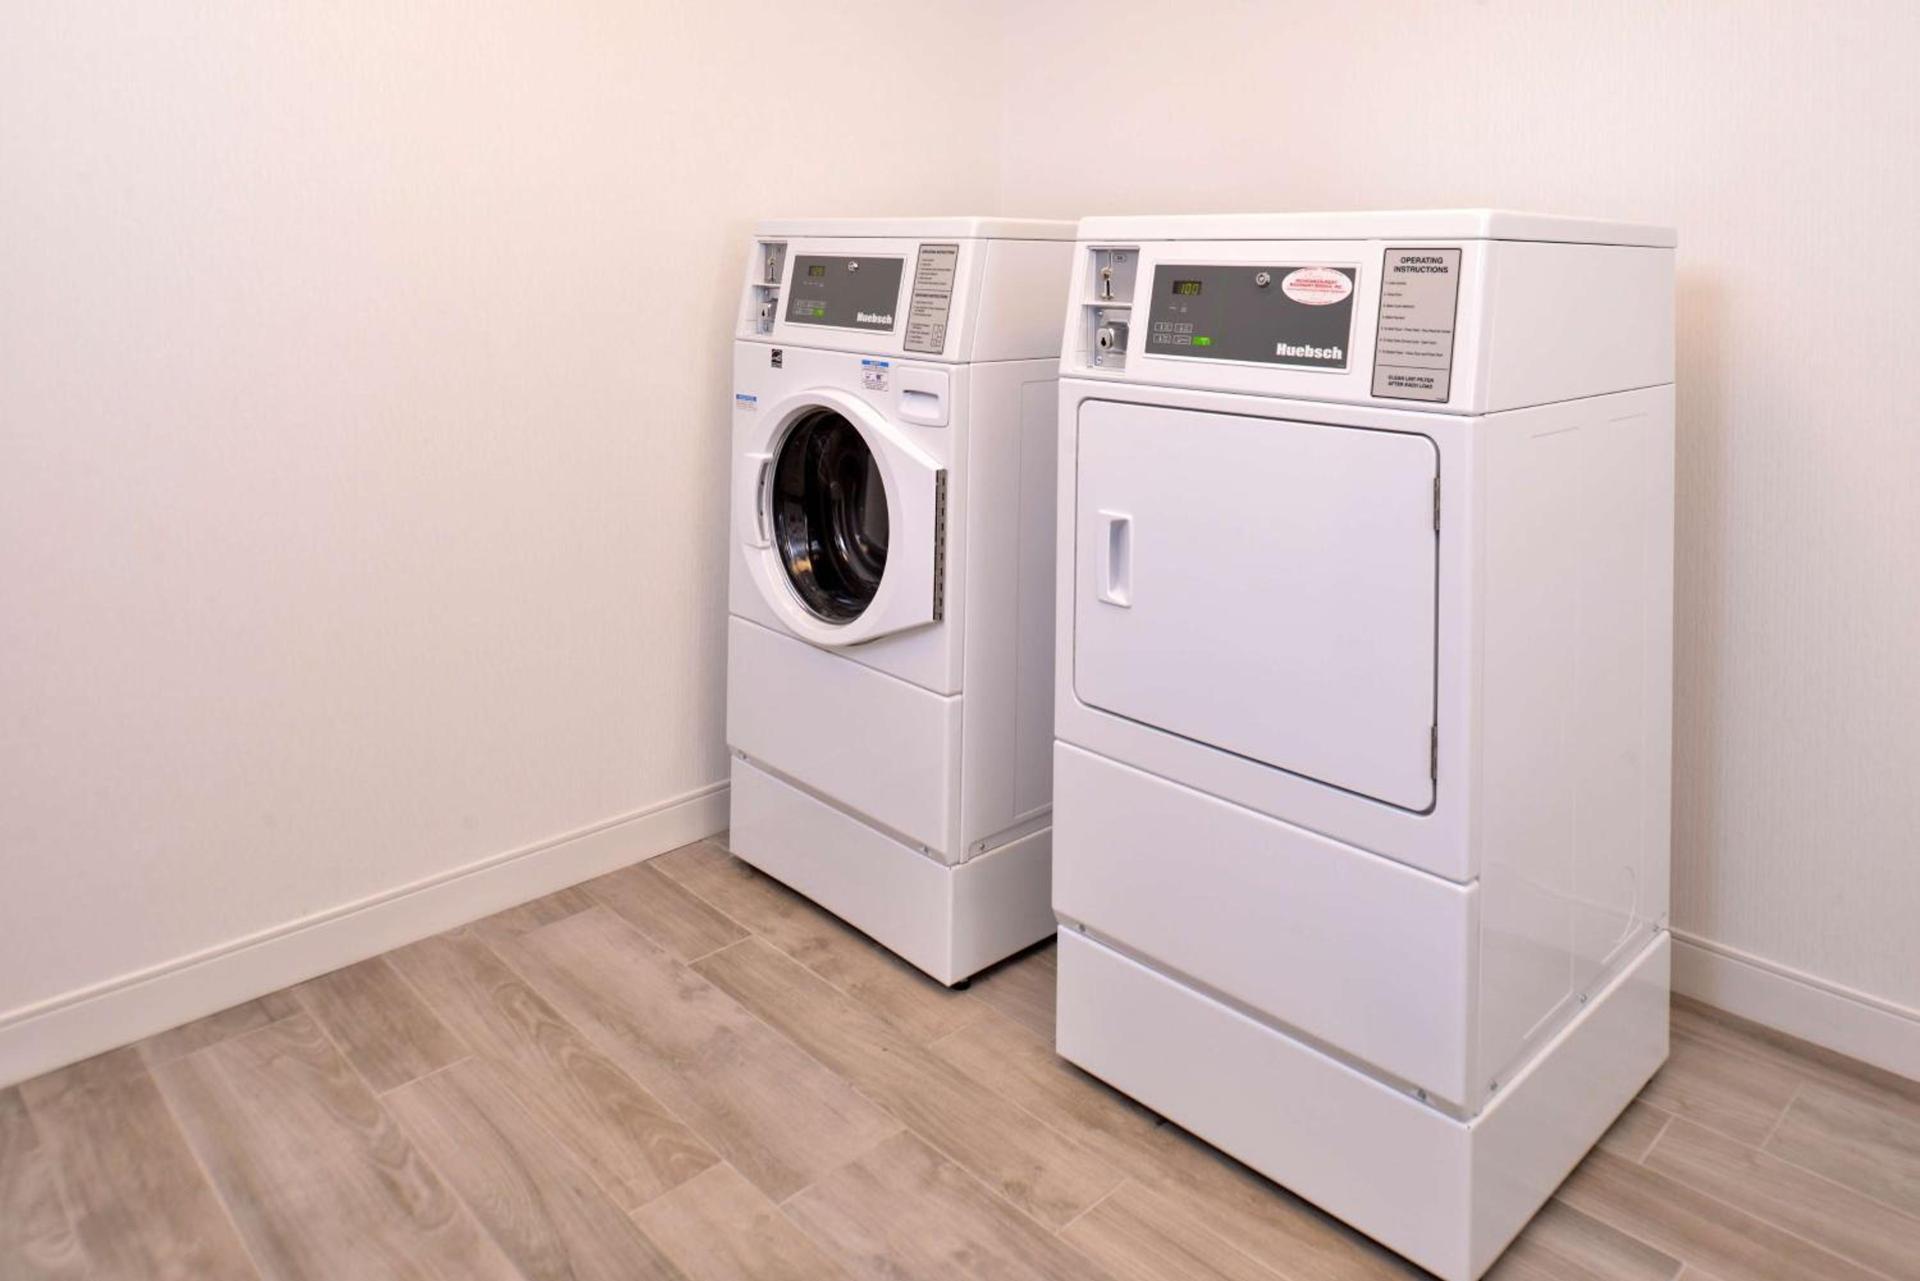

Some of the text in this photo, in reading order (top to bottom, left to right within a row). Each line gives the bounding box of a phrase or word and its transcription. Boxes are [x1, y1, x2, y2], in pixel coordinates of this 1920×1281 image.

[1400, 256, 1444, 264] OPERATING
[856, 311, 893, 324] Huebsch
[1276, 342, 1343, 360] Huebsch
